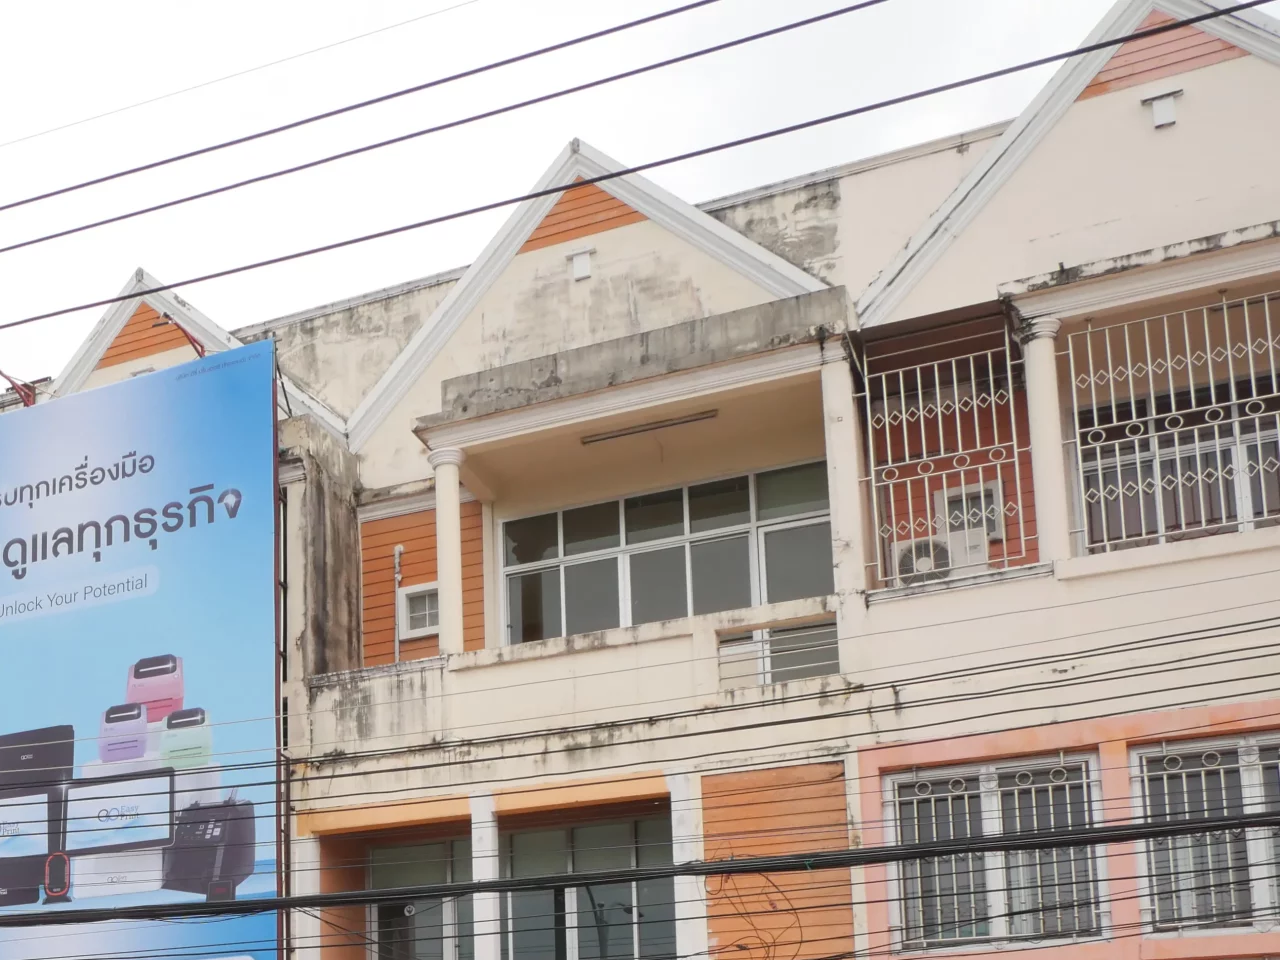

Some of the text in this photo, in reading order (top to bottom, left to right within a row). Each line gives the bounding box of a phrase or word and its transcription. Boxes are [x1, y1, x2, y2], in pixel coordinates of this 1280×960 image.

[47, 590, 78, 608] Your
[84, 573, 149, 601] Potential
[121, 805, 140, 813] Easy
[2, 827, 20, 836] Print
